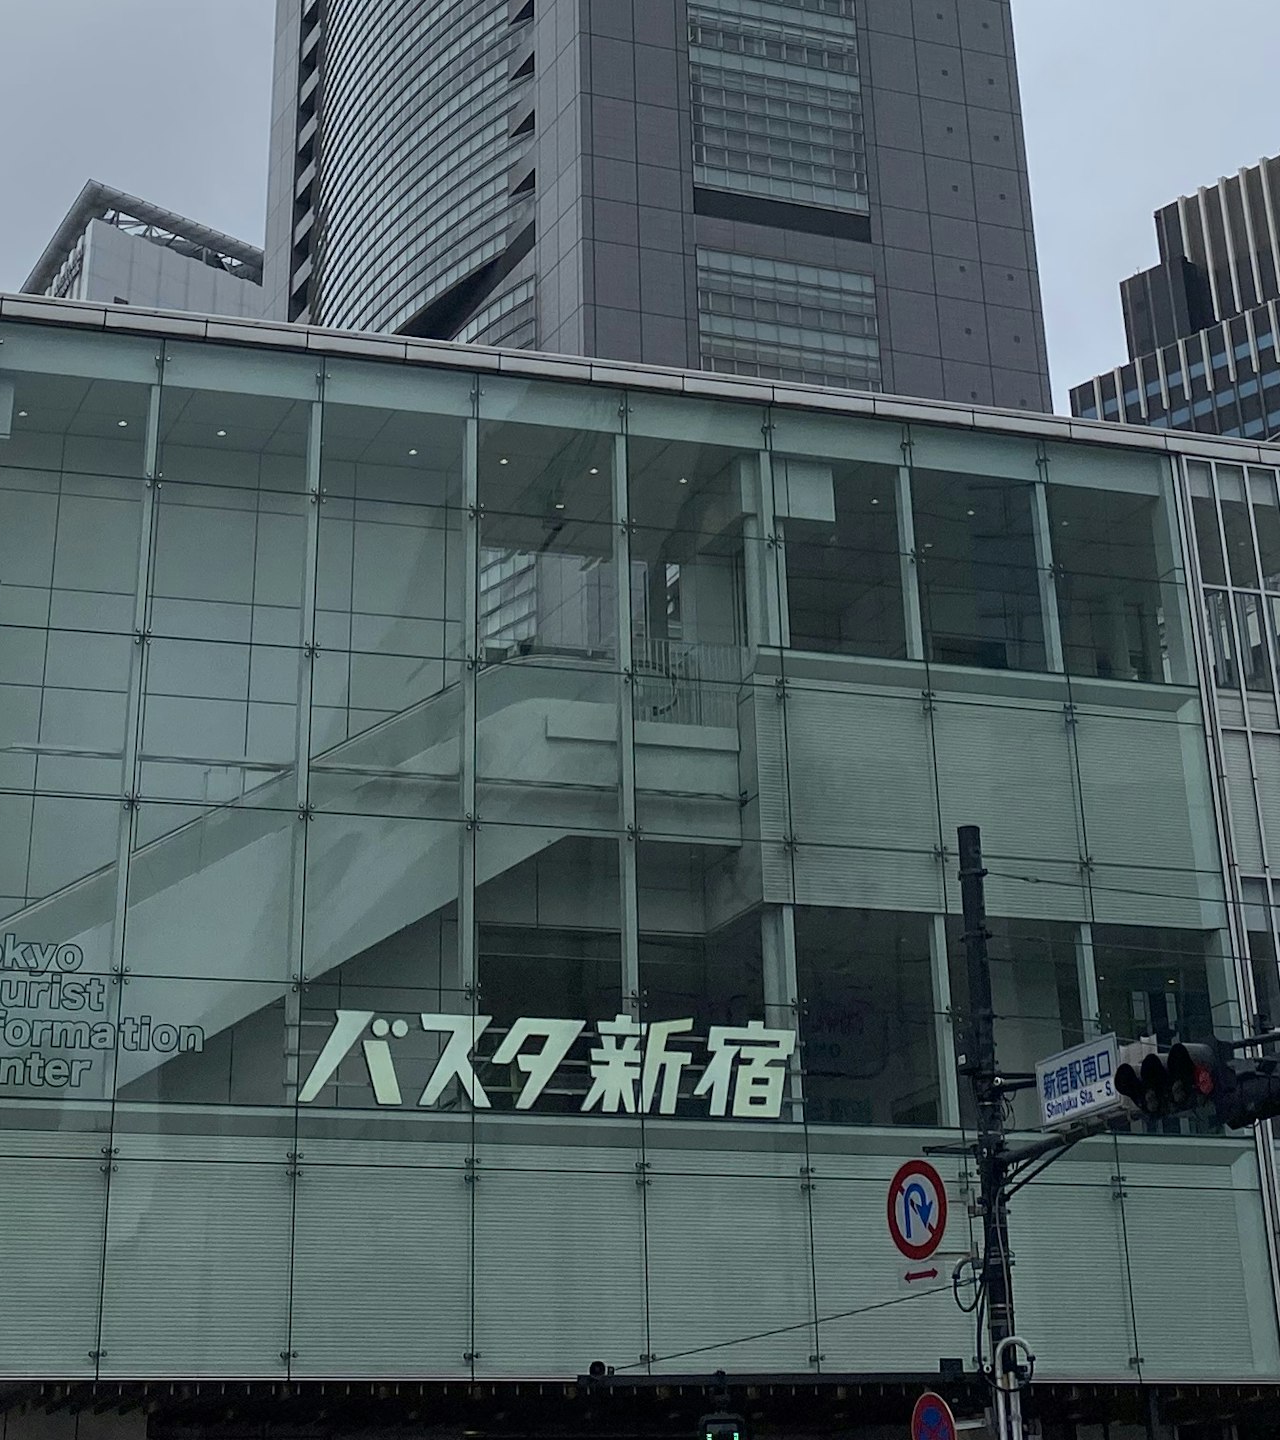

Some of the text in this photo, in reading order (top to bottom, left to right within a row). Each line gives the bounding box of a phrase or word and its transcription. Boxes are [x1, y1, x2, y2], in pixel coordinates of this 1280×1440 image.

[298, 1009, 797, 1119] バスタ新宿
[1043, 1050, 1111, 1101] 新宿駅南口
[1046, 1096, 1078, 1118] Shinjuku
